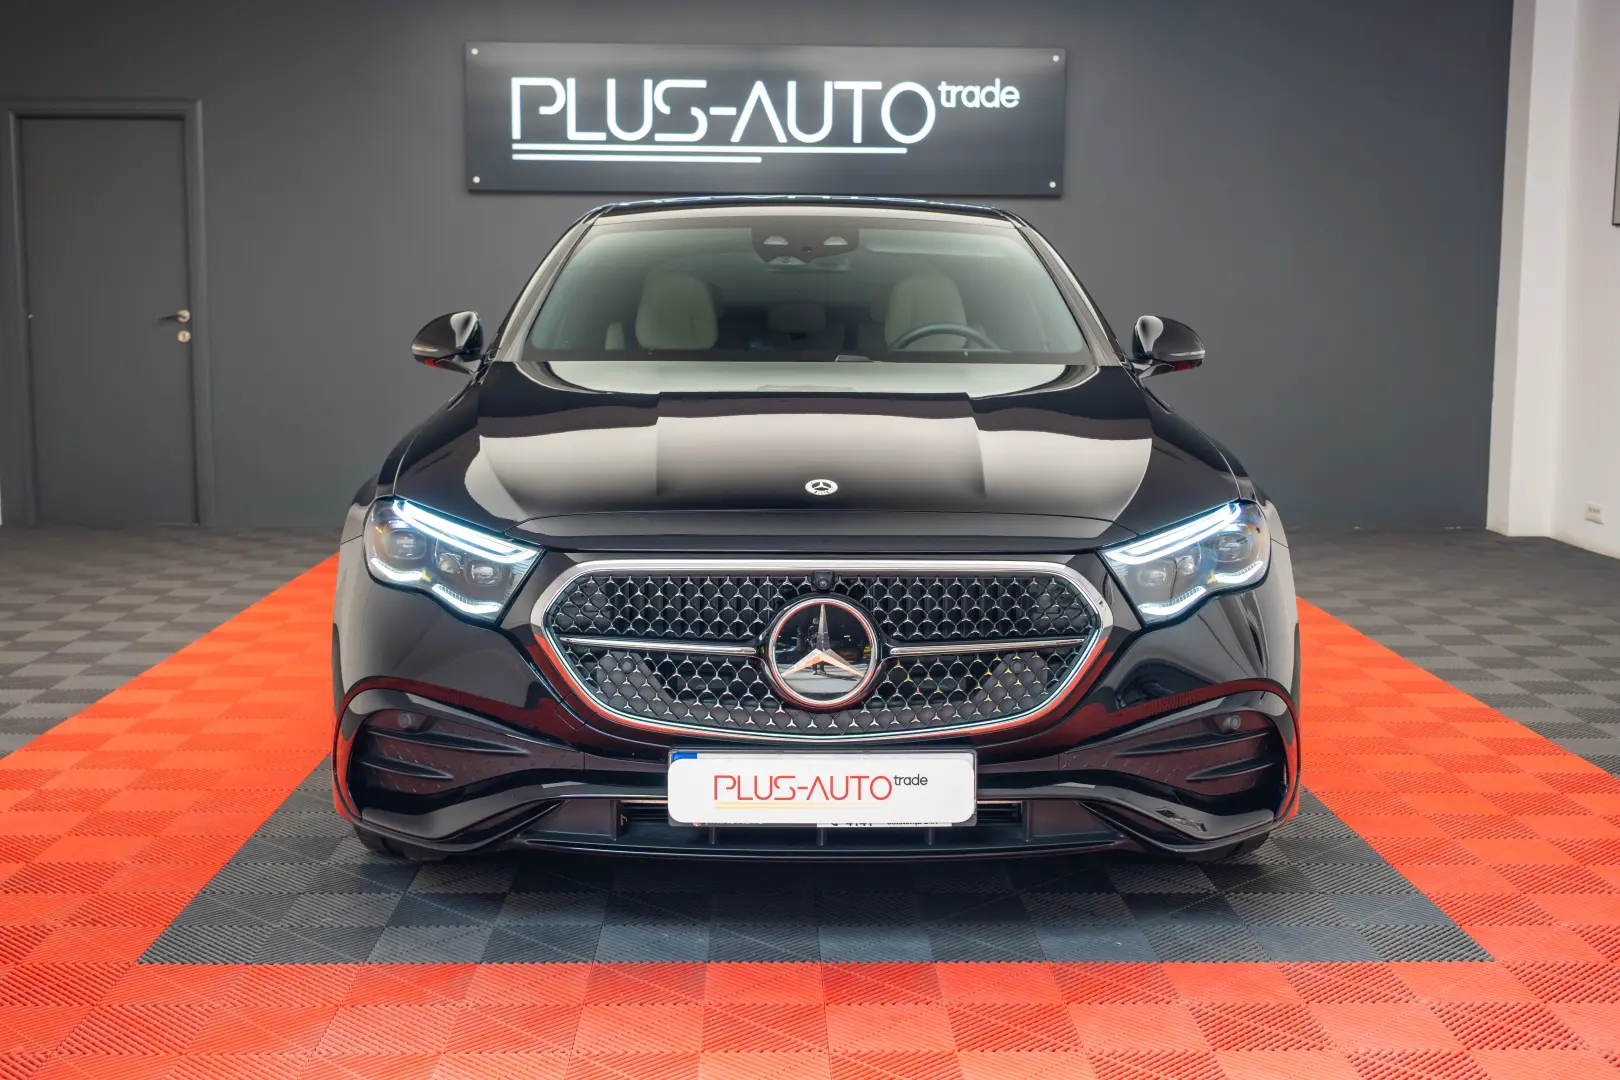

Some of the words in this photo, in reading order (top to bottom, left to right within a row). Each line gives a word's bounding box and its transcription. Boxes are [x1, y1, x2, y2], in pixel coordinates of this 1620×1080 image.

[511, 76, 936, 144] PLUS-AUTO
[938, 78, 1021, 108] trade
[713, 775, 893, 801] PLUS-AUTO
[893, 773, 929, 786] trade
